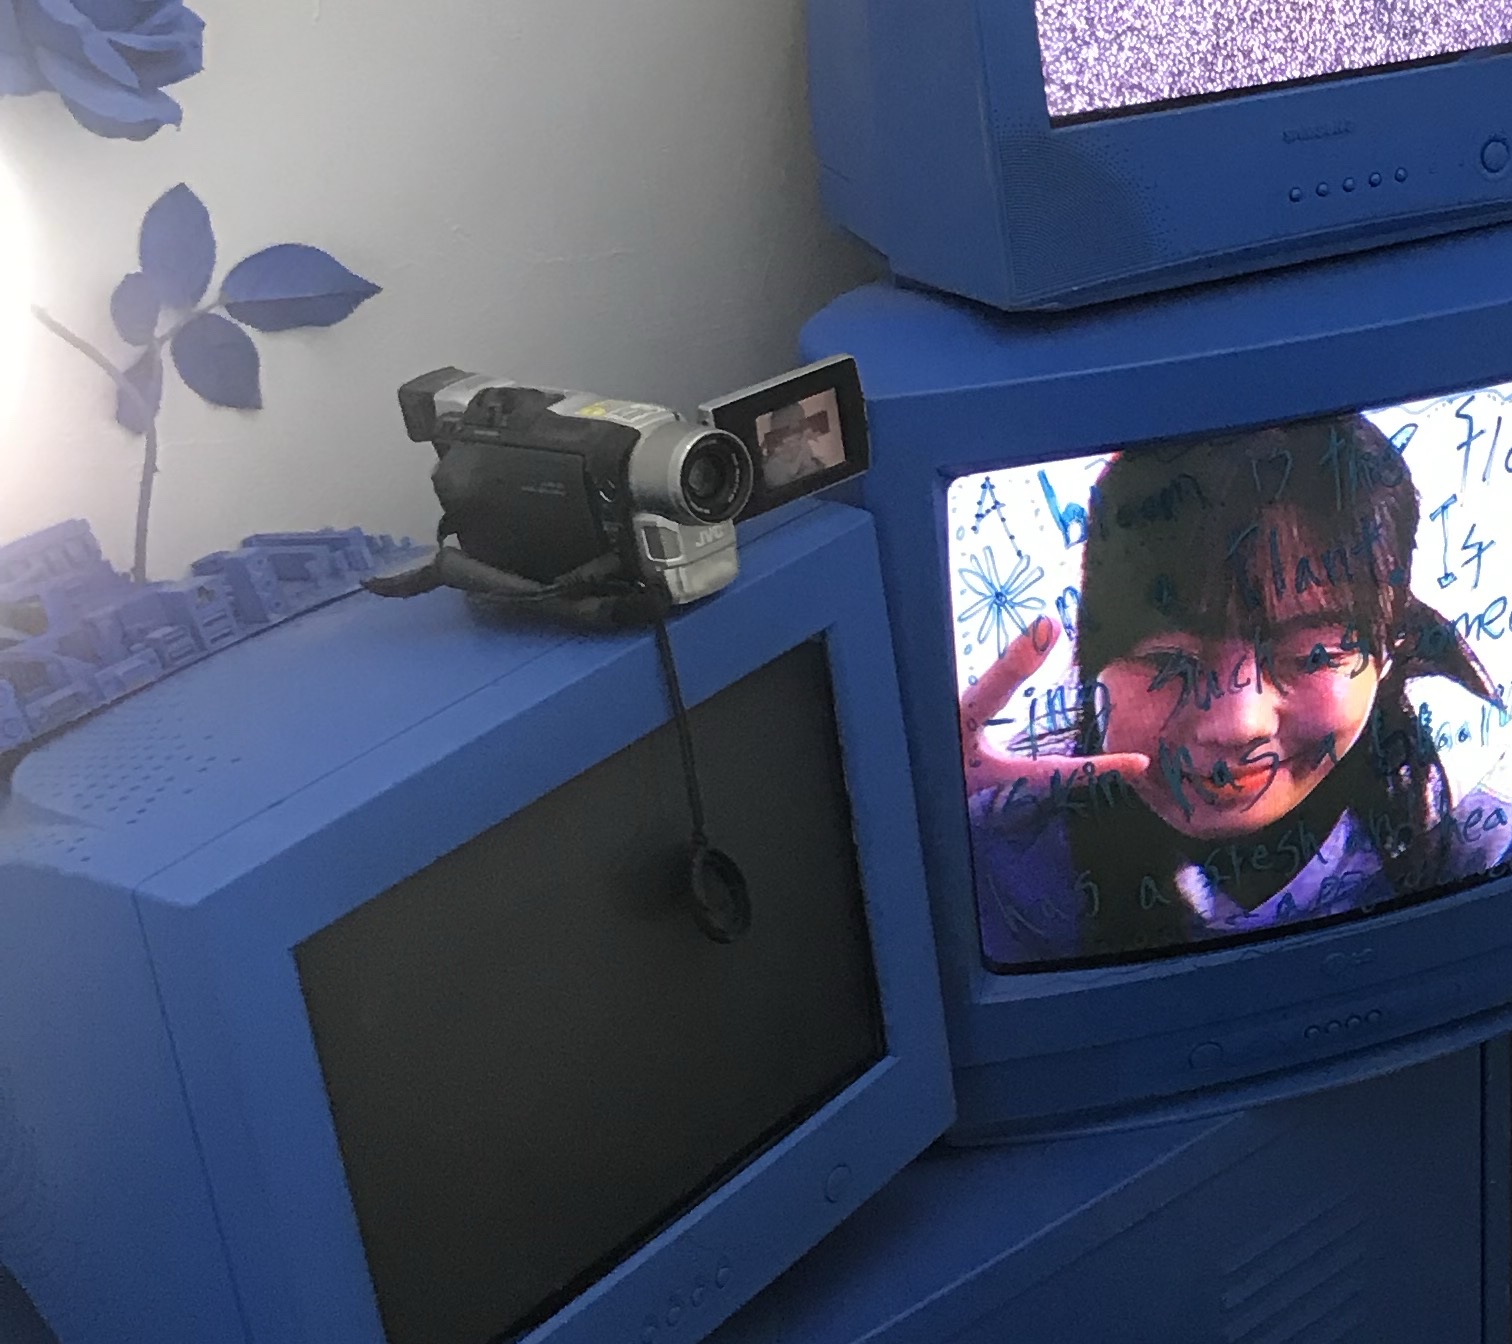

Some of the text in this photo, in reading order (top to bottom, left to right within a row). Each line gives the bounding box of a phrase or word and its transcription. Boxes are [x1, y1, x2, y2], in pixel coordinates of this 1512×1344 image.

[972, 476, 1024, 557] A
[695, 525, 724, 547] JVC
[1139, 873, 1172, 910] a
